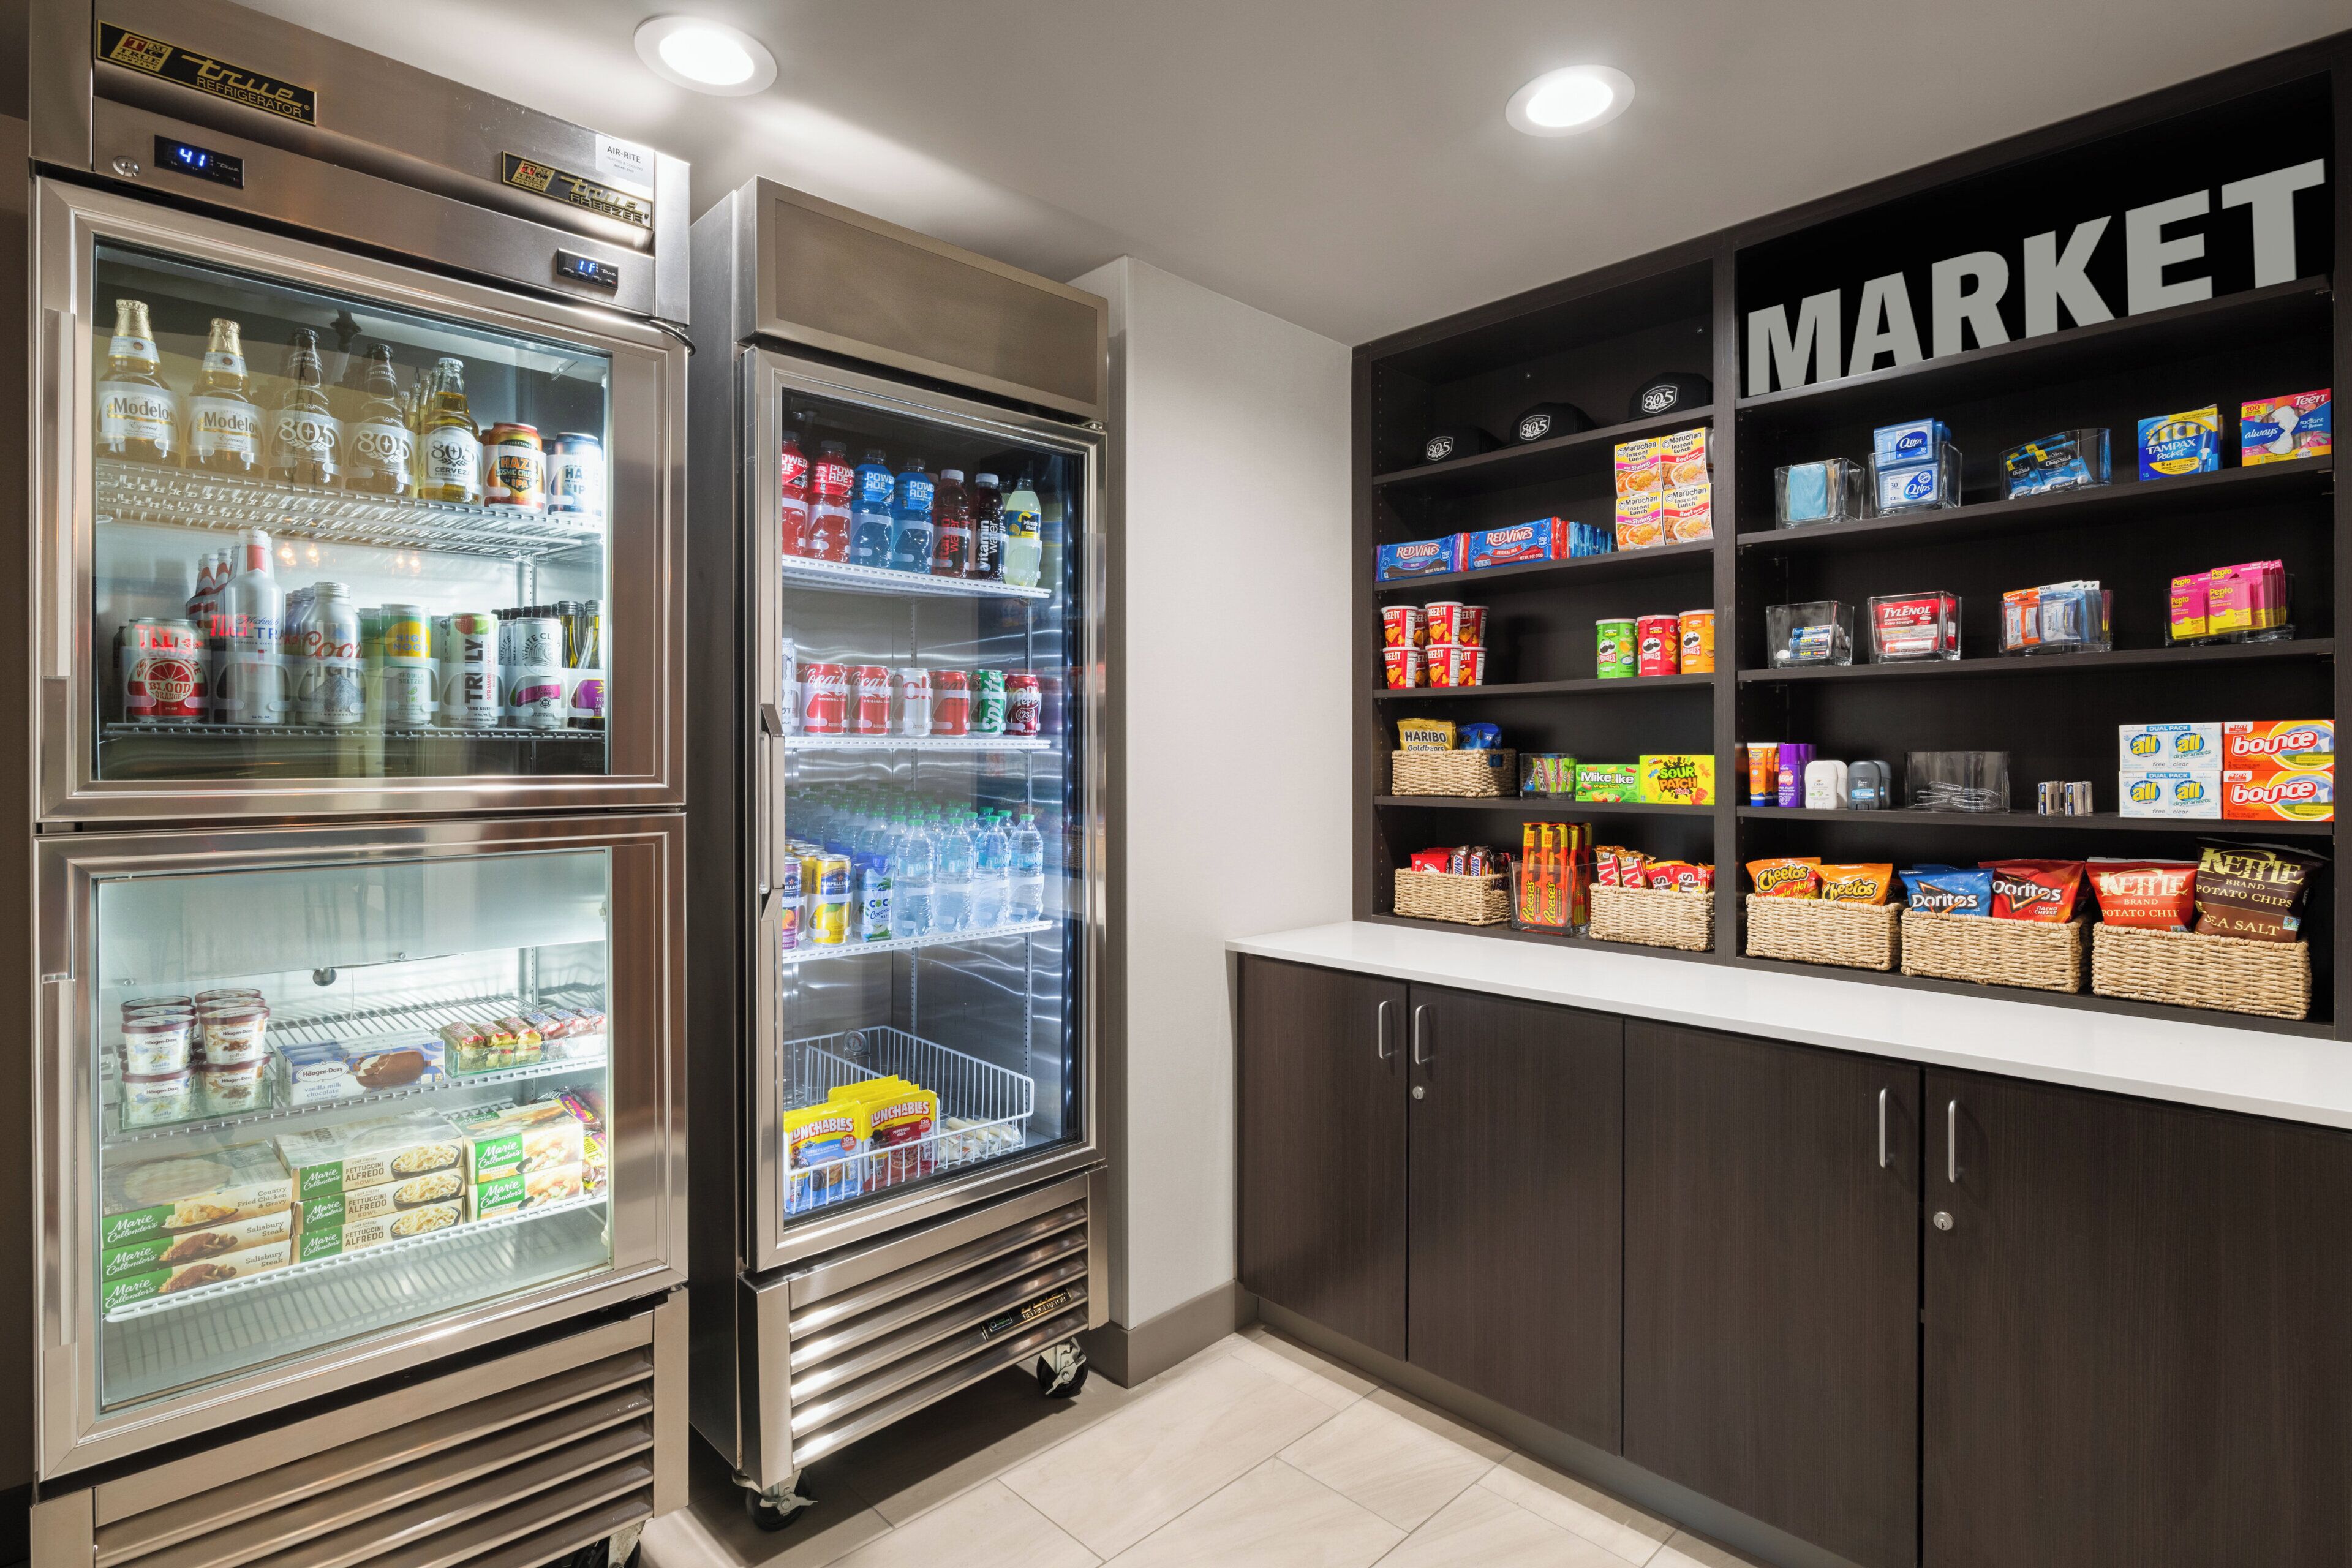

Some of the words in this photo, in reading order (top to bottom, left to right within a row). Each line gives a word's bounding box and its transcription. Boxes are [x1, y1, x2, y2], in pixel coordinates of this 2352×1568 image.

[120, 48, 160, 62] TRUE
[197, 77, 301, 117] REFRIGERATOR
[608, 146, 641, 163] AIR-RITE
[570, 194, 643, 223] FREEZER
[1748, 157, 2325, 398] MARKET
[1645, 392, 1676, 407] 805
[2294, 394, 2325, 406] Teen
[114, 398, 168, 419] Modelo
[204, 412, 254, 432] Modelo
[1521, 420, 1548, 434] 805
[279, 417, 335, 446] 805
[1670, 432, 1702, 444] Maruchan
[2245, 428, 2278, 439] always
[357, 430, 409, 459] 805
[431, 440, 474, 461] 805
[1428, 441, 1452, 454] 805
[1624, 442, 1656, 453] Maruchan
[1672, 441, 1694, 450] Instant
[2146, 439, 2196, 455] TAMPAX
[1626, 450, 1648, 458] Instant
[1676, 454, 1689, 462] Beef
[2045, 455, 2072, 467] ChapStick
[2157, 448, 2186, 461] Pocket
[1632, 461, 1651, 470] Shrimp
[512, 479, 528, 488] IPA
[829, 472, 848, 483] ADE
[865, 480, 886, 490] ADE
[910, 489, 929, 498] ADE
[1672, 488, 1706, 498] Maruchan
[1626, 496, 1657, 507] Maruchan
[1632, 515, 1652, 524] Shrimp
[978, 520, 989, 568] vitamin
[989, 520, 998, 554] water
[2211, 568, 2233, 578] Pepto
[2173, 578, 2191, 587] Pepto
[2209, 587, 2233, 597] Pepto
[2171, 596, 2190, 605] Pepto
[1883, 606, 1931, 619] TYLENOL
[1642, 651, 1661, 661] PRINGLES
[1683, 646, 1700, 655] PRINGLES
[1599, 654, 1616, 663] PRINGLES
[149, 682, 190, 693] BLOOD
[982, 670, 1003, 734] Sprite
[1404, 731, 1447, 743] HARIBO
[2176, 733, 2201, 752] all
[2234, 731, 2315, 755] bounce
[2132, 734, 2157, 755] all
[2190, 750, 2211, 758] sheets
[1581, 772, 1611, 783] Mike
[1615, 774, 1635, 784] Ike
[1660, 766, 1695, 778] SOUR
[1659, 777, 1698, 791] PATCH
[2176, 781, 2201, 800] all
[2132, 782, 2157, 801] all
[2234, 782, 2315, 803] bounce
[2198, 846, 2304, 886] KETTLE
[1758, 864, 1809, 891] Cheetos
[2097, 867, 2188, 898] KETTLE
[2226, 879, 2265, 890] BRAND
[1793, 881, 1809, 895] Hot
[1822, 880, 1878, 902] Cheetos
[1992, 880, 2062, 903] Doritos
[1522, 880, 1536, 922] Reese's
[1544, 881, 1556, 925] Reese's
[1912, 893, 1978, 909] Doritos
[2196, 884, 2248, 900] POTATO
[2251, 894, 2293, 908] CHIPS
[2102, 909, 2146, 918] POTATO
[2204, 914, 2229, 929] SEA
[2234, 920, 2280, 937] SALT
[303, 1066, 343, 1077] Häagen-Dazs
[307, 1089, 339, 1098] chocolate
[871, 1101, 930, 1128] LUNCHABLES
[790, 1118, 854, 1145] LUNCHABLES
[479, 1142, 518, 1160] Marie
[478, 1149, 522, 1169] Callender's
[307, 1167, 339, 1184] Marie
[345, 1162, 384, 1175] FETTUCCINI
[303, 1175, 341, 1191] Callender's
[345, 1169, 385, 1183] ALFREDO
[258, 1186, 287, 1197] Country
[481, 1181, 521, 1199] Marie
[257, 1193, 287, 1205] Chicken
[265, 1199, 287, 1208] Gravy
[348, 1194, 386, 1207] FETTUCCINI
[480, 1189, 523, 1208] Callender's
[310, 1200, 341, 1216] Marie
[348, 1200, 387, 1214] ALFREDO
[115, 1214, 154, 1231] Marie
[306, 1208, 344, 1224] Callender's
[107, 1221, 157, 1243] Callender's
[247, 1221, 284, 1234] Salisbury
[262, 1226, 284, 1237] Steak
[345, 1226, 384, 1238] FETTUCCINI
[307, 1232, 338, 1249] Marie
[345, 1232, 385, 1246] ALFREDO
[113, 1246, 153, 1264] Marie
[303, 1240, 341, 1256] Callender's
[246, 1251, 283, 1264] Salisbury
[261, 1257, 283, 1267] Steak
[106, 1254, 157, 1276] Callender's
[112, 1279, 151, 1296] Marie
[105, 1286, 156, 1308] Callender's
[1023, 1296, 1067, 1320] REFRIGERATOR
